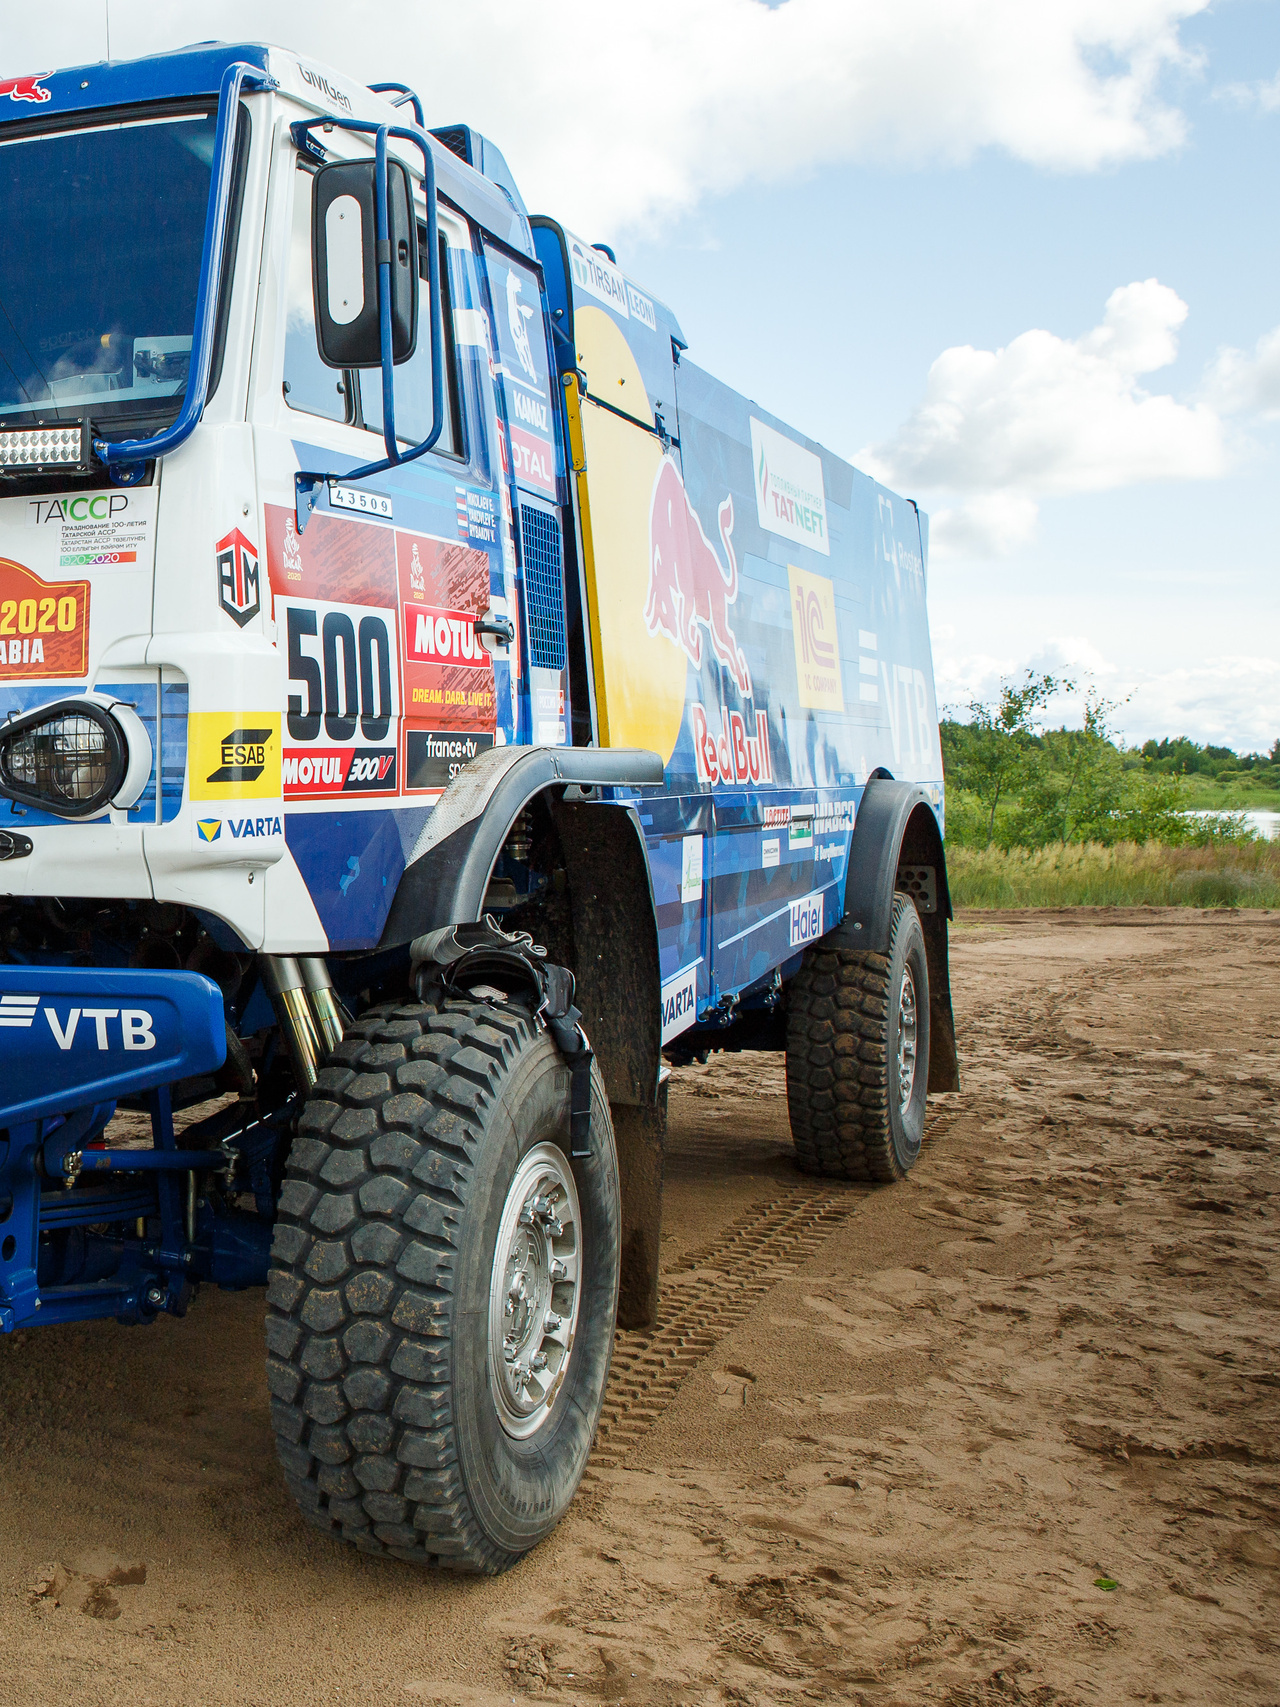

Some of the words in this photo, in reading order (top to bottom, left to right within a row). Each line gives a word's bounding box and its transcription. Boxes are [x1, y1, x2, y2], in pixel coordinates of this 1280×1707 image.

[628, 296, 655, 326] LEONI
[513, 389, 549, 433] KAMAZ
[335, 491, 388, 513] 43509
[772, 490, 823, 537] TATNEFT
[62, 522, 110, 531] ПРАЗДНОВАНИЕ
[111, 520, 146, 528] 100-ЛЕТИЯ
[62, 530, 96, 538] ТАТАРСКОЙ
[61, 553, 119, 565] 1920-2020
[282, 554, 304, 572] DAKAR
[287, 571, 301, 581] 2020
[413, 591, 424, 600] 2020
[0, 597, 77, 635] 2020
[414, 613, 483, 660] MOTUL
[286, 607, 391, 742] 500
[412, 688, 443, 704] DREAM.
[468, 692, 483, 706] LIVE
[483, 692, 492, 706] IT.
[881, 660, 932, 765] VTB
[221, 746, 265, 765] ESAB
[691, 703, 728, 786] Red
[730, 709, 772, 785] Bull
[283, 757, 343, 785] MOTUL
[348, 755, 395, 782] 300V
[227, 817, 282, 838] VARTA
[814, 800, 855, 835] WABCO
[792, 902, 822, 943] Haier
[661, 984, 694, 1028] VARTA
[43, 1008, 156, 1051] VTB
